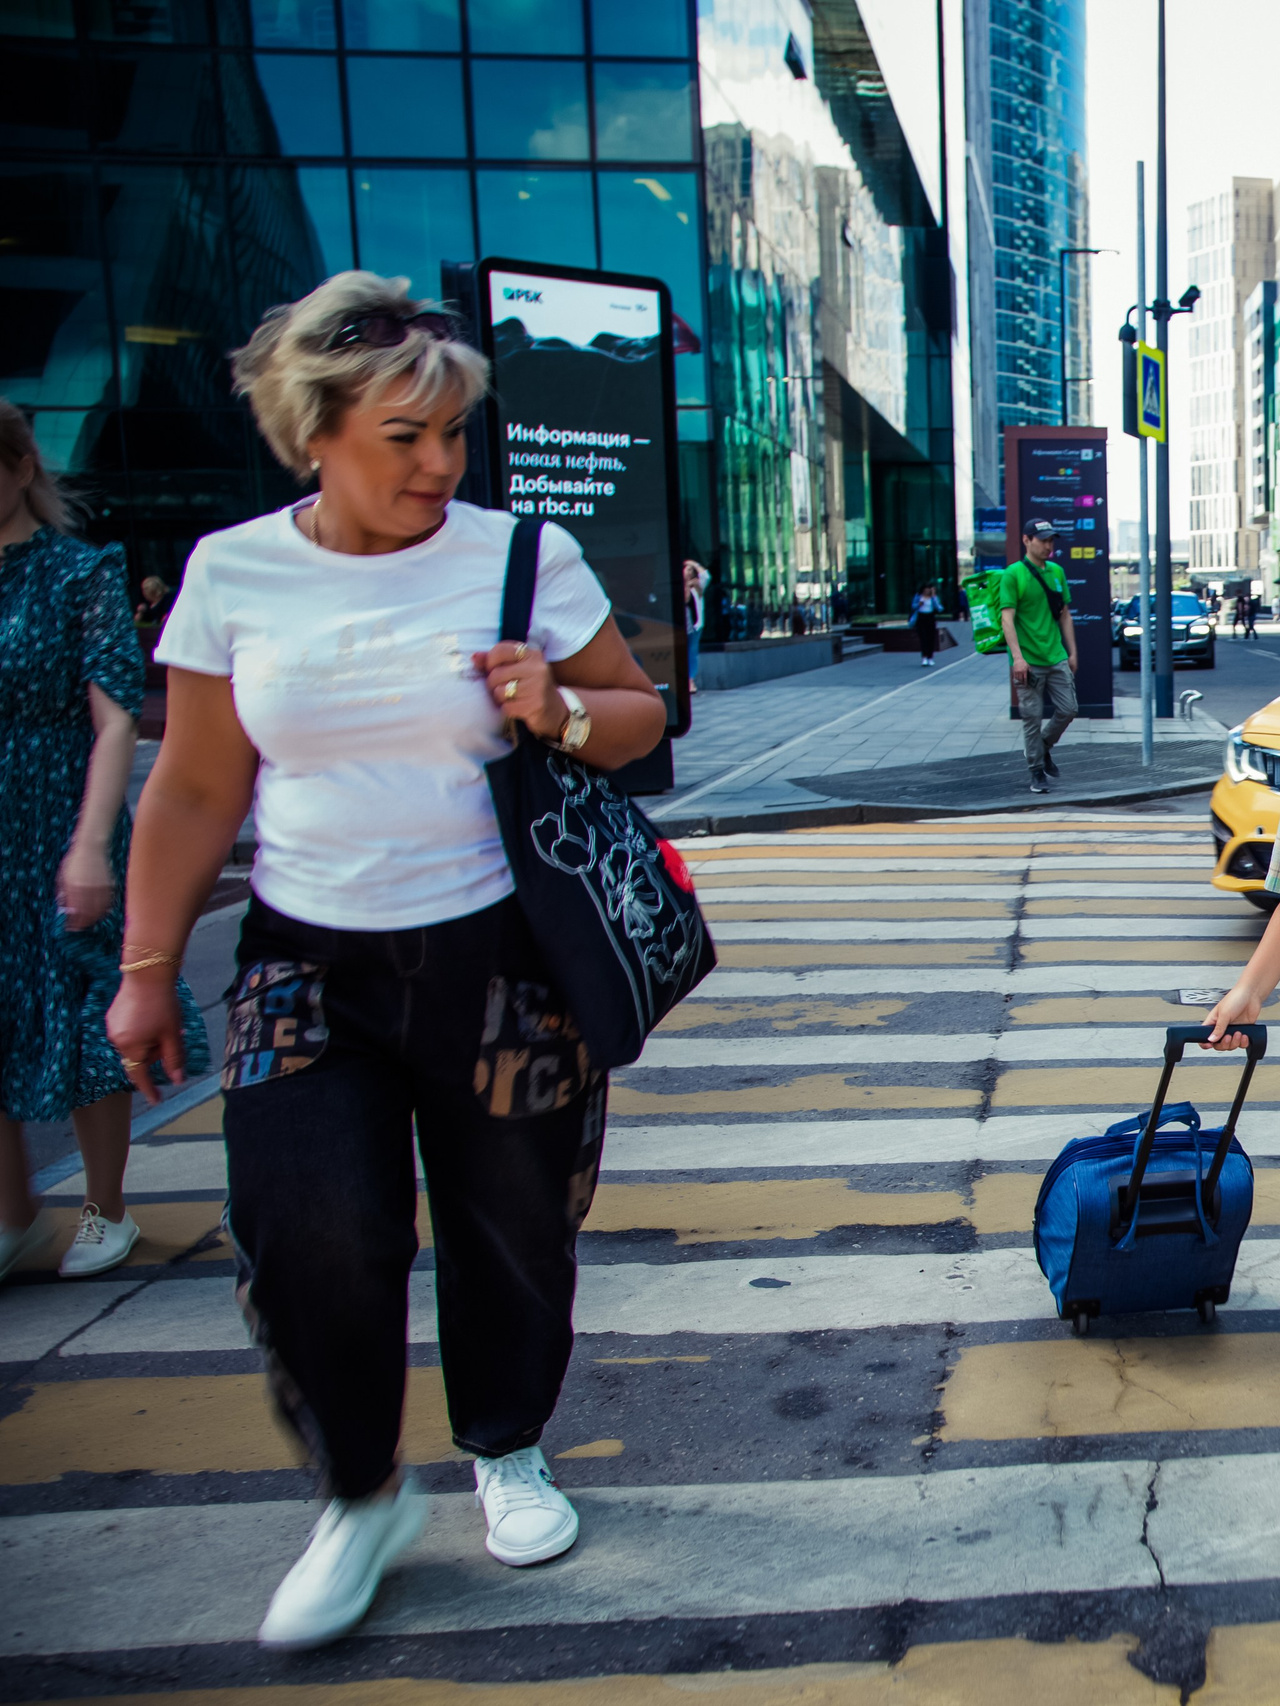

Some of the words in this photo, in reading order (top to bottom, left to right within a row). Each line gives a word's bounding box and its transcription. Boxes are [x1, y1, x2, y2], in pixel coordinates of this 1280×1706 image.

[515, 288, 544, 305] РБК
[507, 422, 631, 449] Информация
[508, 451, 562, 469] новая
[565, 451, 627, 475] нефть.
[509, 474, 616, 497] Добывайте
[511, 499, 536, 514] на
[538, 496, 595, 517] rbc.ru
